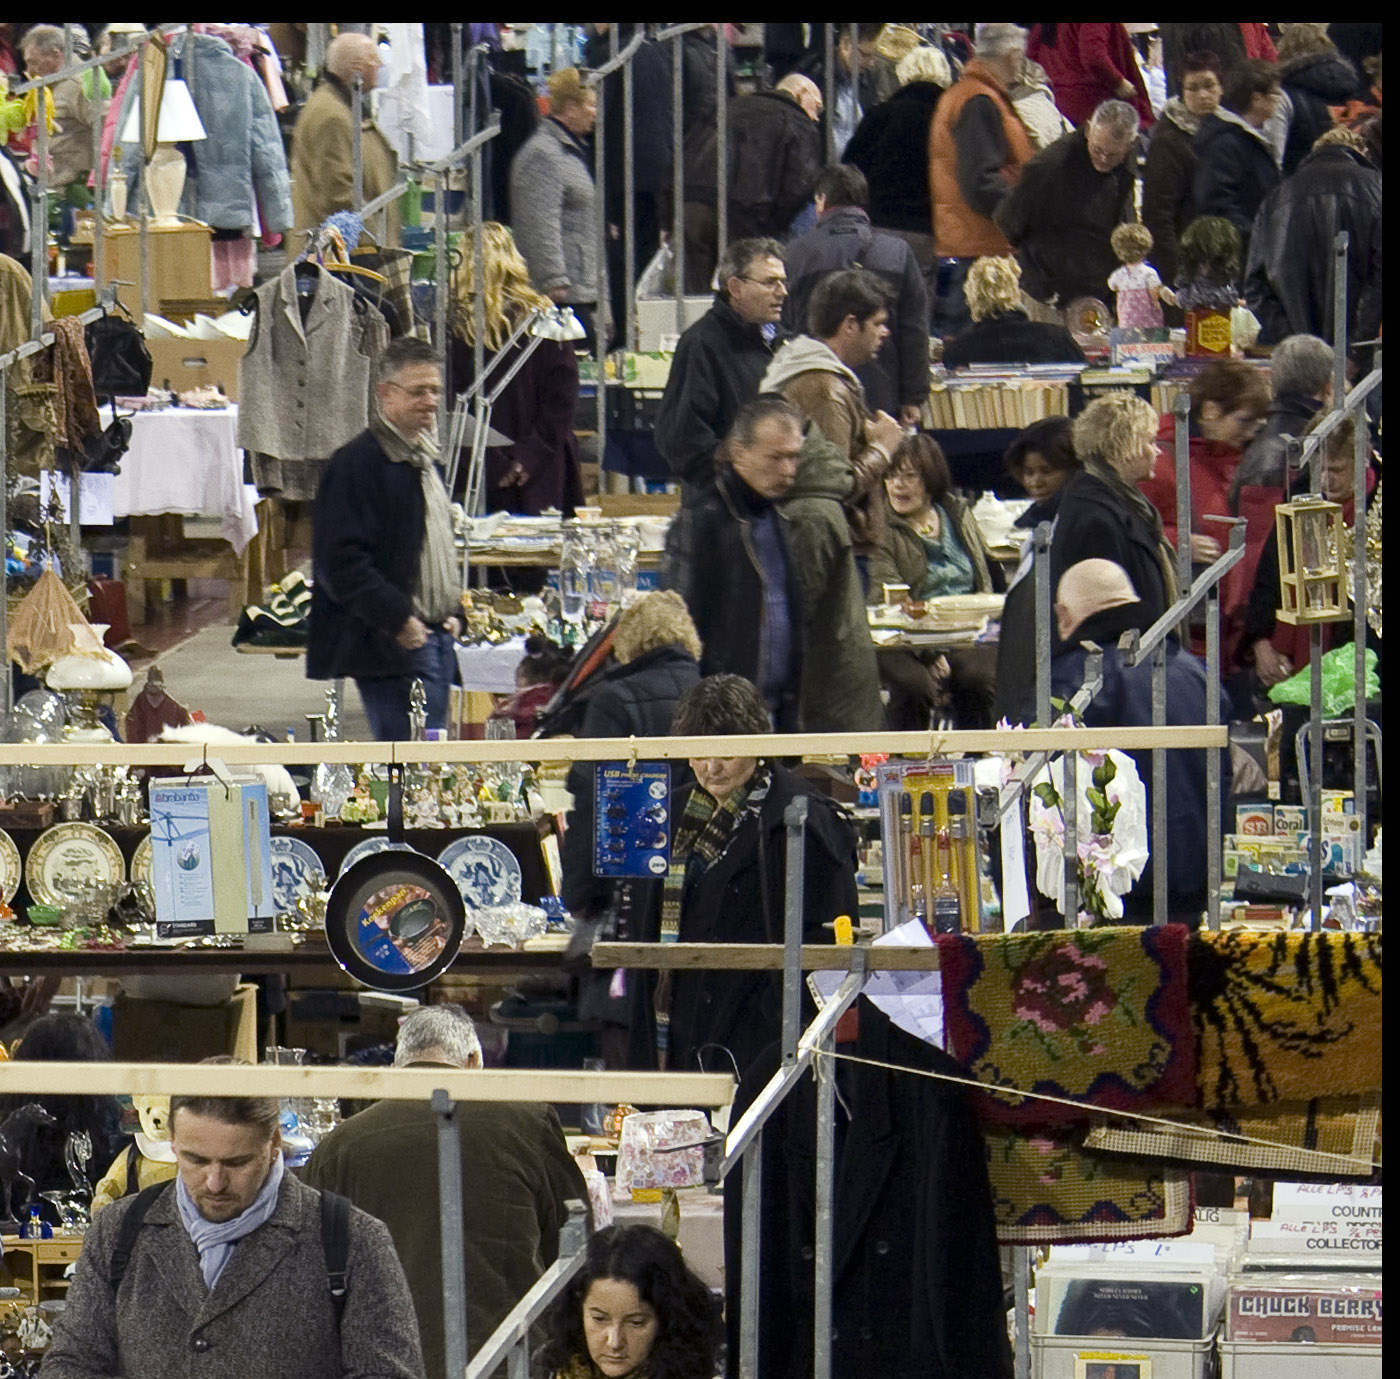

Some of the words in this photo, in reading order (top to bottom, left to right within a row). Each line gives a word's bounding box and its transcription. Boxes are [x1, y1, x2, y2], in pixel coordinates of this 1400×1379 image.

[604, 769, 621, 778] USB
[1275, 818, 1303, 831] Coral
[1239, 1295, 1311, 1319] CHUCK
